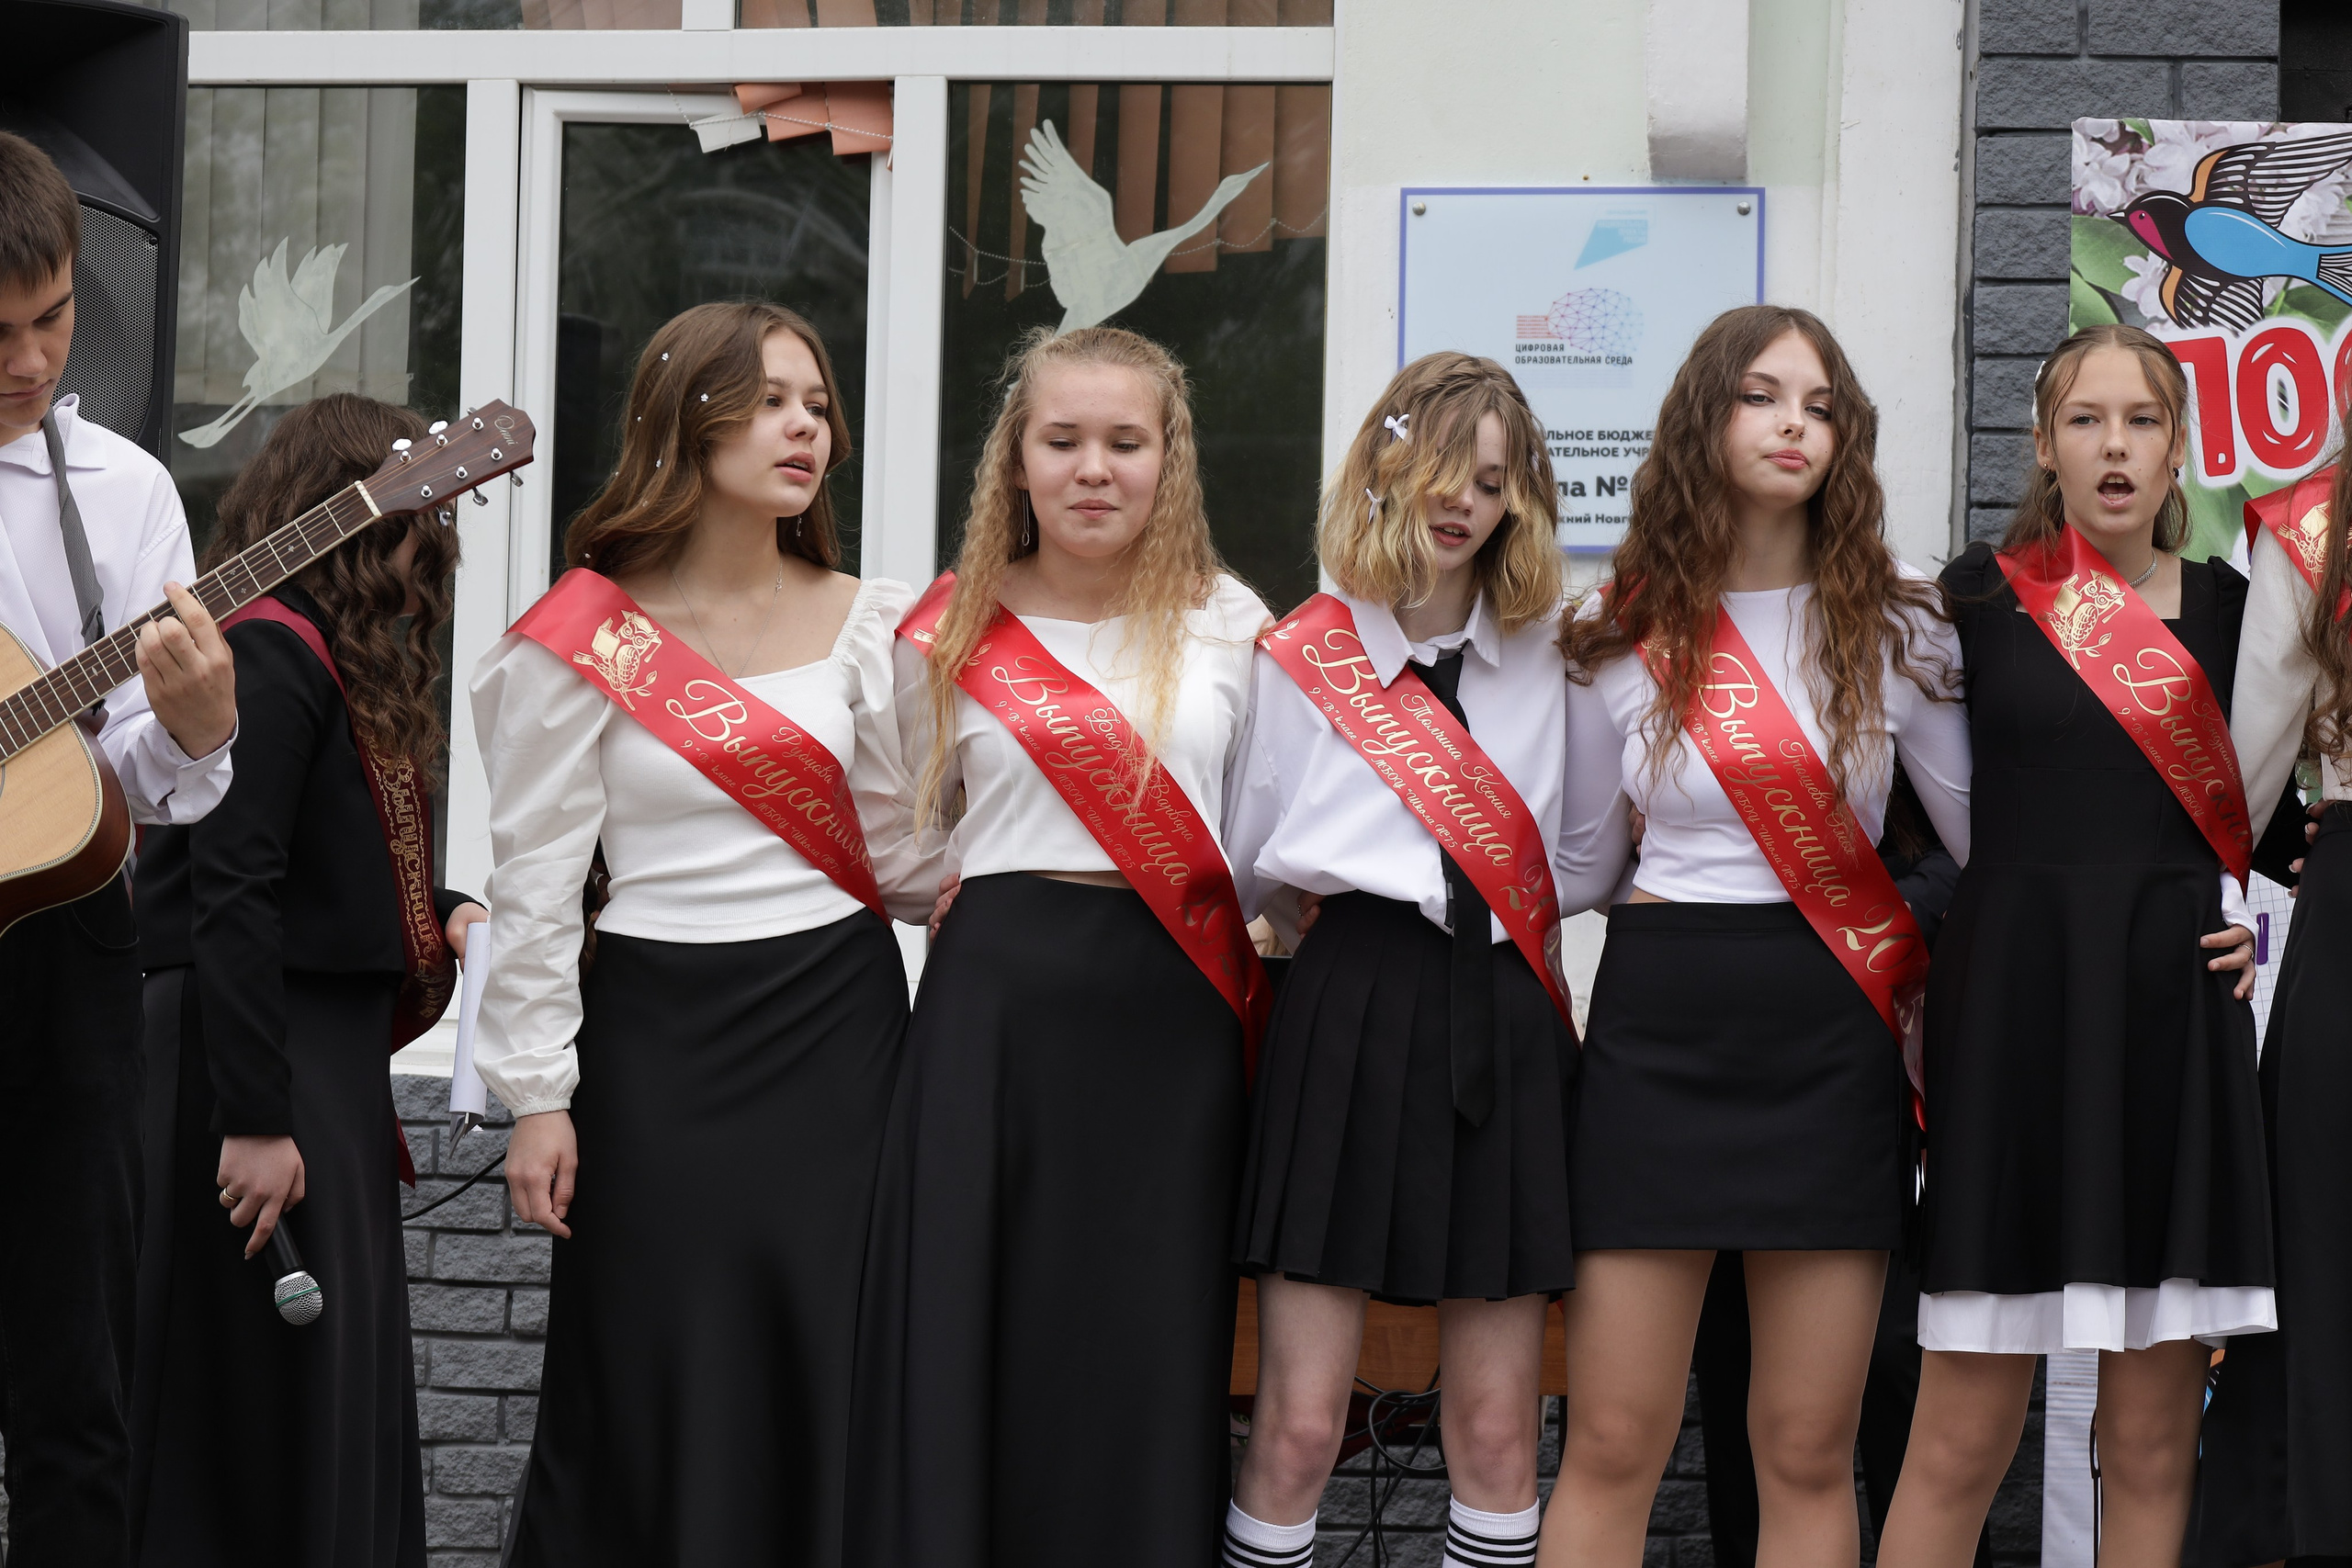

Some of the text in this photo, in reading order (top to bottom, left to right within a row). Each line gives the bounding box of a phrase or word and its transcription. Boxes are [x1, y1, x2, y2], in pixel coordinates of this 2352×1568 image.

[1515, 344, 1565, 353] ЦИФРОВАЯ
[1515, 355, 1633, 366] ОБРАЗОВАТЕЛЬНАЯ СРЕДА
[1597, 430, 1655, 442] БЮДЖЕ
[665, 679, 873, 874] Выпускница
[681, 739, 694, 750] 9
[710, 764, 736, 789] класс
[752, 801, 790, 830] МБОУ
[772, 727, 833, 784] Рубцова
[991, 655, 1192, 886] Выпускница
[995, 699, 1008, 710] 9
[1019, 724, 1041, 753] класс
[1054, 772, 1087, 807] МБОУ
[1302, 628, 1510, 866] Выпускница
[1308, 687, 1321, 695] 9
[1334, 714, 1358, 740] класс
[1370, 757, 1407, 791] МБОУ
[1434, 823, 1459, 849] №75
[1400, 694, 1511, 819] Толчина Ксения
[1697, 651, 1851, 908] Выпускница
[1701, 737, 1721, 765] класс
[1731, 786, 1760, 824] МБОУ
[2118, 706, 2131, 716] 9
[2143, 738, 2165, 765] класс
[2176, 784, 2205, 818] МБОУ
[1147, 773, 1194, 842] Варвара
